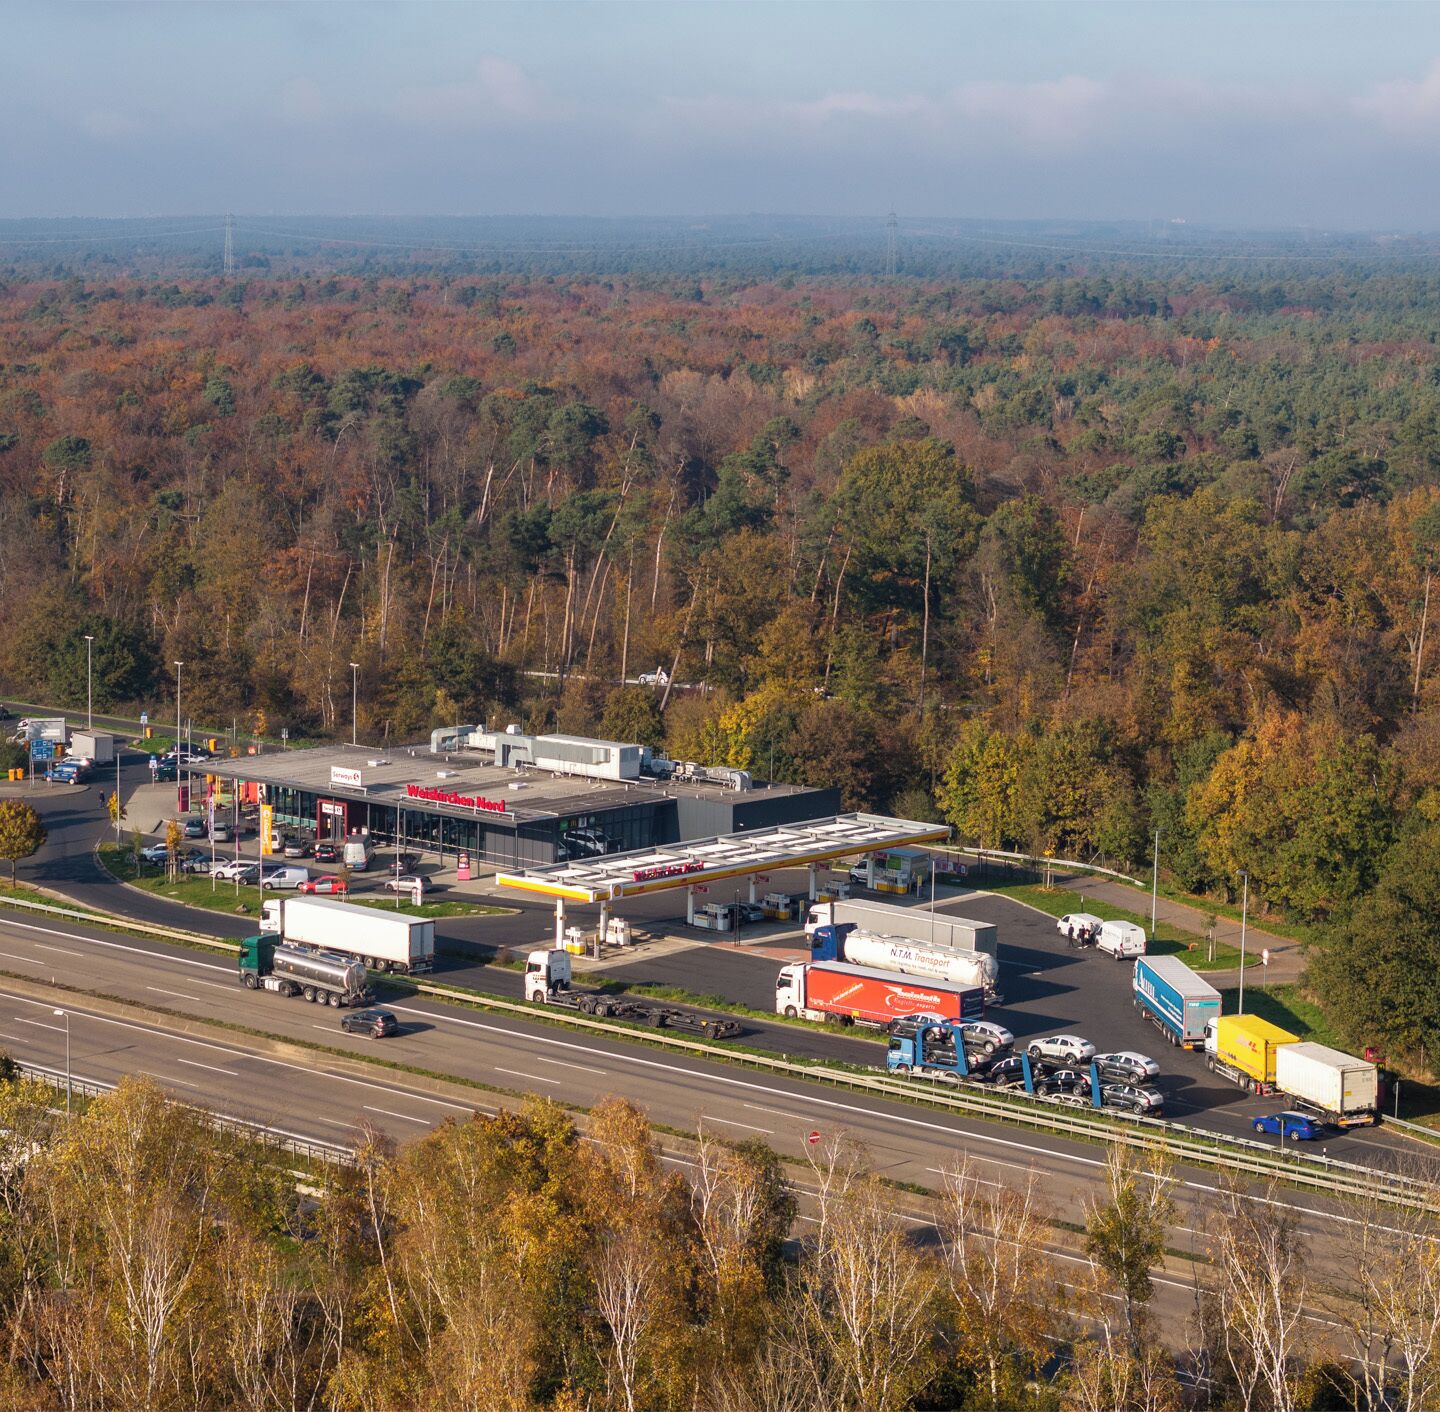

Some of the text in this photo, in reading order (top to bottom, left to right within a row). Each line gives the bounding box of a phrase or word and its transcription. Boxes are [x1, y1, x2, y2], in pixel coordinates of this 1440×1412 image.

[333, 771, 353, 781] Serways
[407, 784, 506, 812] Weiskirchen Nord
[890, 948, 950, 967] N.T.M. Transport
